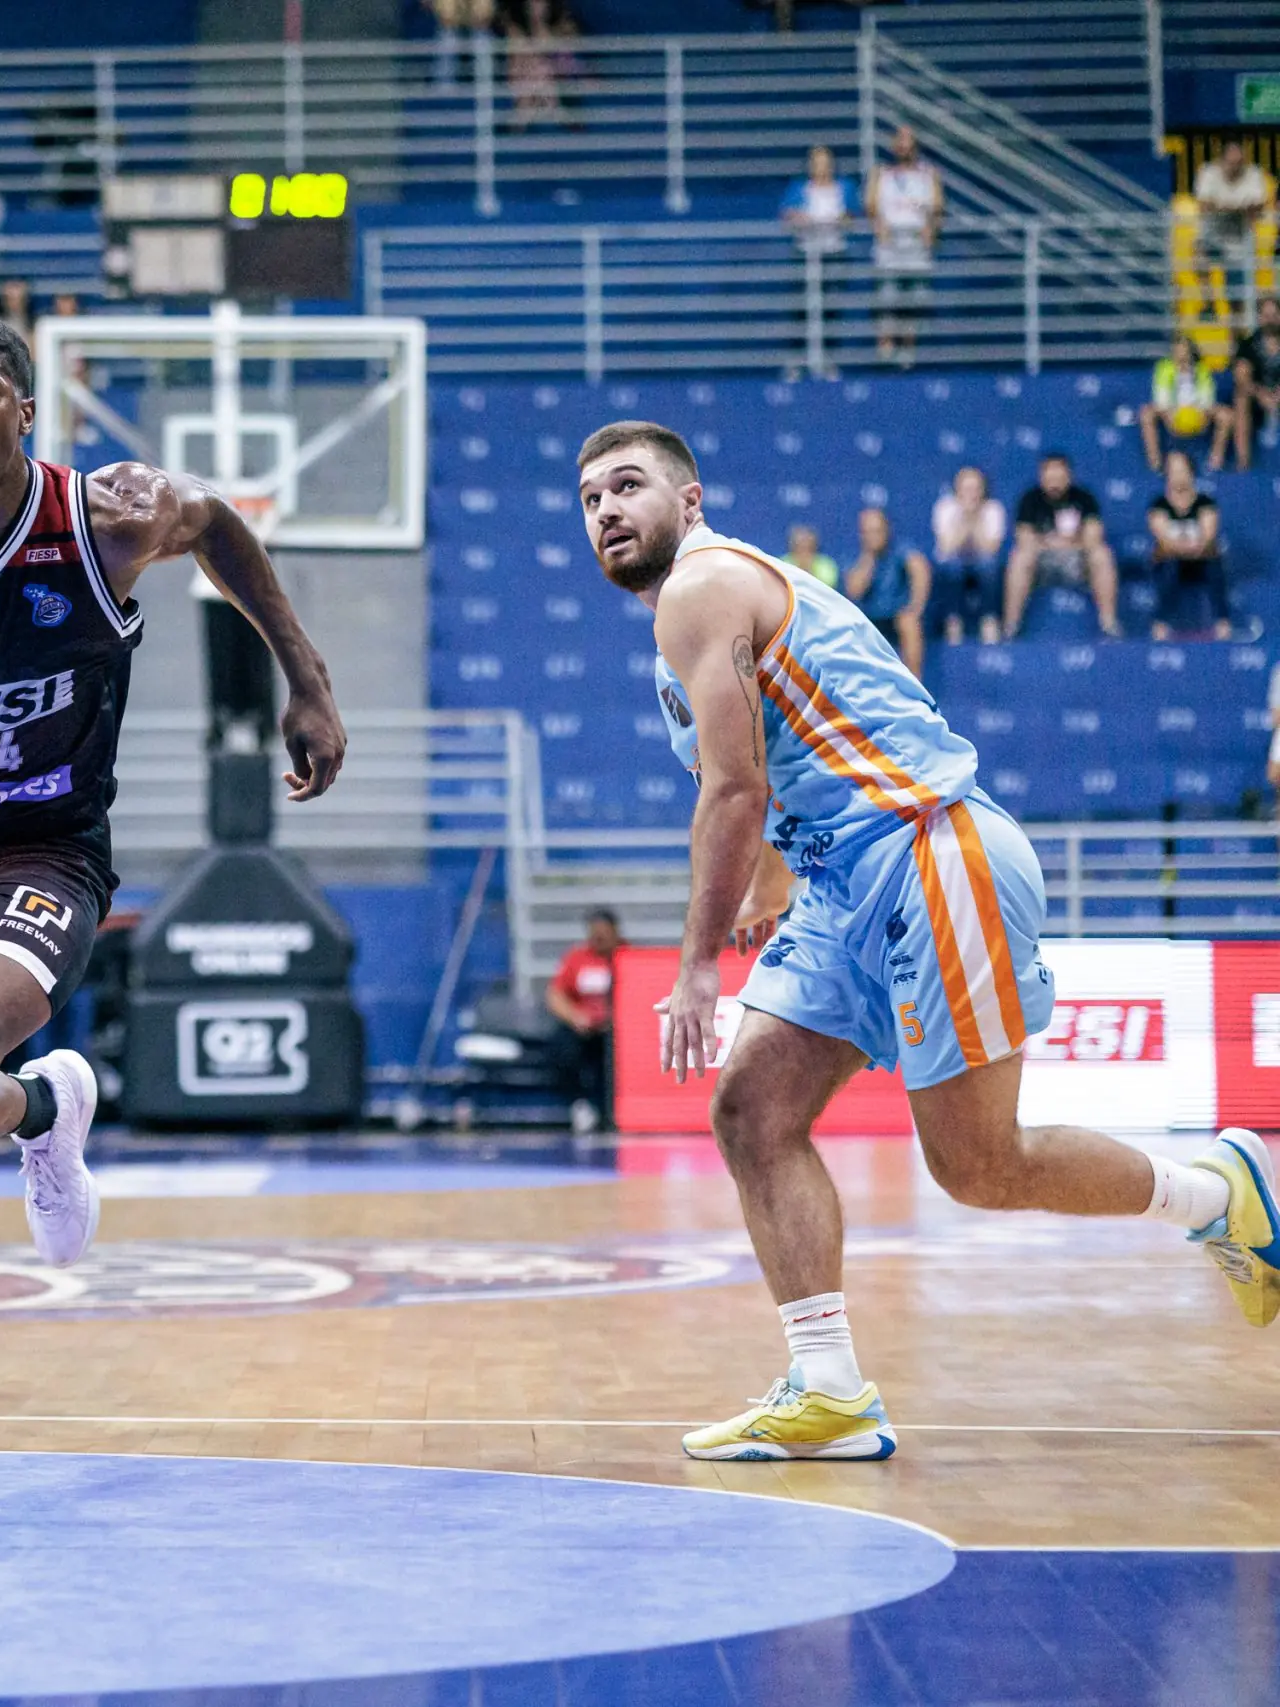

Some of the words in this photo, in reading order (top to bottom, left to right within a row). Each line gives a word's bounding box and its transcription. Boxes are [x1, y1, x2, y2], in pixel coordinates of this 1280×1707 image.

[28, 549, 58, 560] FIESP
[896, 1001, 925, 1046] 5
[1024, 1005, 1150, 1061] ESI
